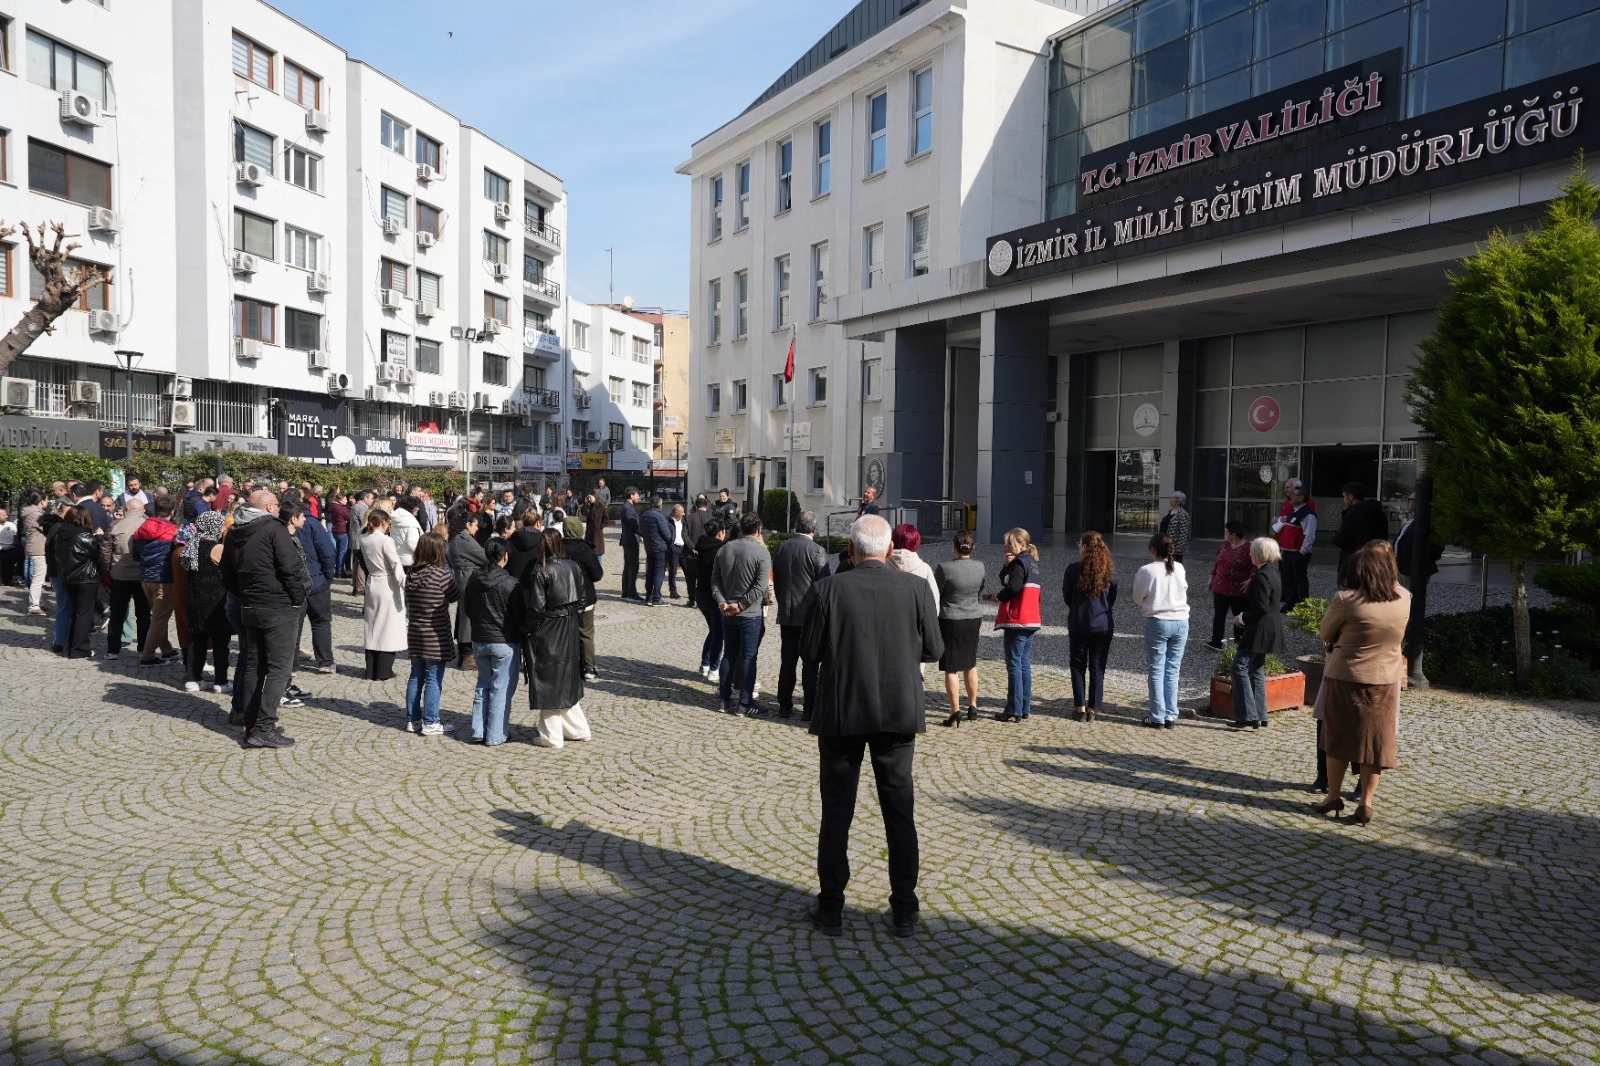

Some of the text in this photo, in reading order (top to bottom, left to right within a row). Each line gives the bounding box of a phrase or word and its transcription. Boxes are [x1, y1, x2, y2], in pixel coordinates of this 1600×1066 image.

[1081, 71, 1383, 196] T.C. İZMİR VALİLİĞİ
[1016, 86, 1583, 269] İZMİR İL MİLLÎ EĞİTİM MÜDÜRLÜĞÜ
[289, 413, 320, 424] MARKA
[288, 422, 338, 439] OUTLET
[104, 436, 138, 449] SAĞLK
[365, 437, 391, 454] BİROL
[429, 436, 454, 447] MEDİKAL
[353, 454, 403, 469] ORTODONTİ
[477, 455, 488, 466] DİŞ
